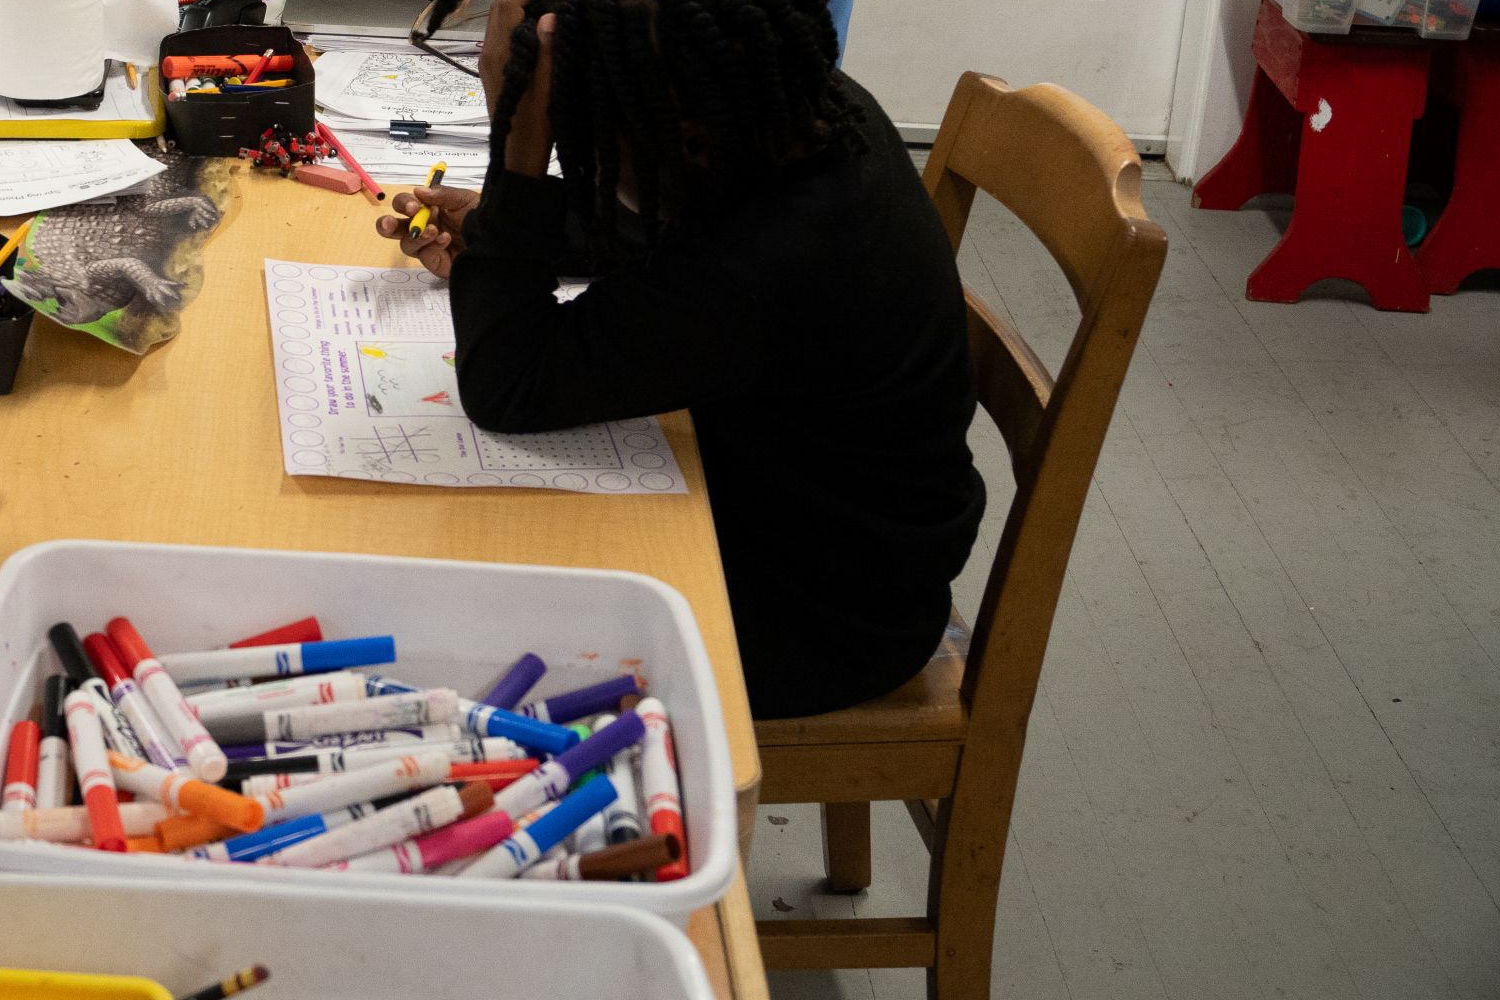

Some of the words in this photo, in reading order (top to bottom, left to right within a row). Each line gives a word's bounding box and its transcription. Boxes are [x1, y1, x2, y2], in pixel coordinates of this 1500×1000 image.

[319, 340, 331, 356] thing
[321, 358, 333, 382] favorite
[341, 374, 351, 384] the
[325, 384, 338, 397] your
[327, 399, 339, 415] Draw
[345, 400, 355, 408] to
